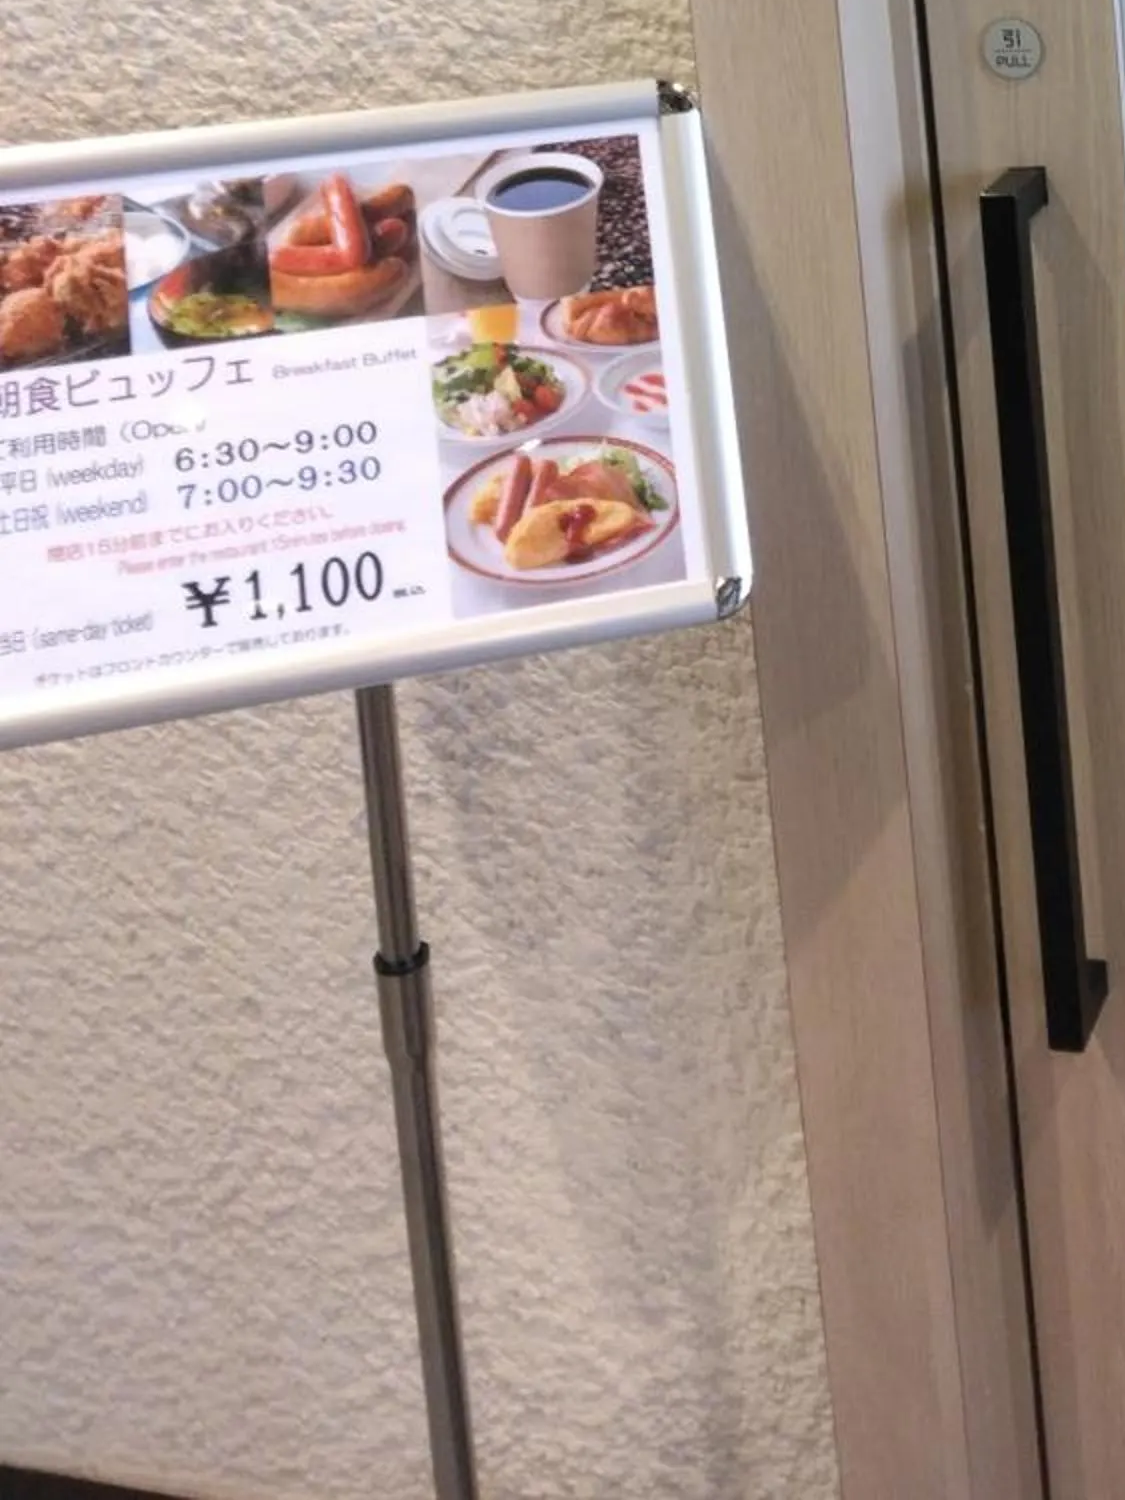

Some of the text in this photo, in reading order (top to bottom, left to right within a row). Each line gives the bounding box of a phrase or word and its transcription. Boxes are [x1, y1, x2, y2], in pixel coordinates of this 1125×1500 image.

[271, 356, 358, 381] Breakfast
[362, 348, 417, 368] Buffet
[180, 550, 384, 628] ¥1,100
